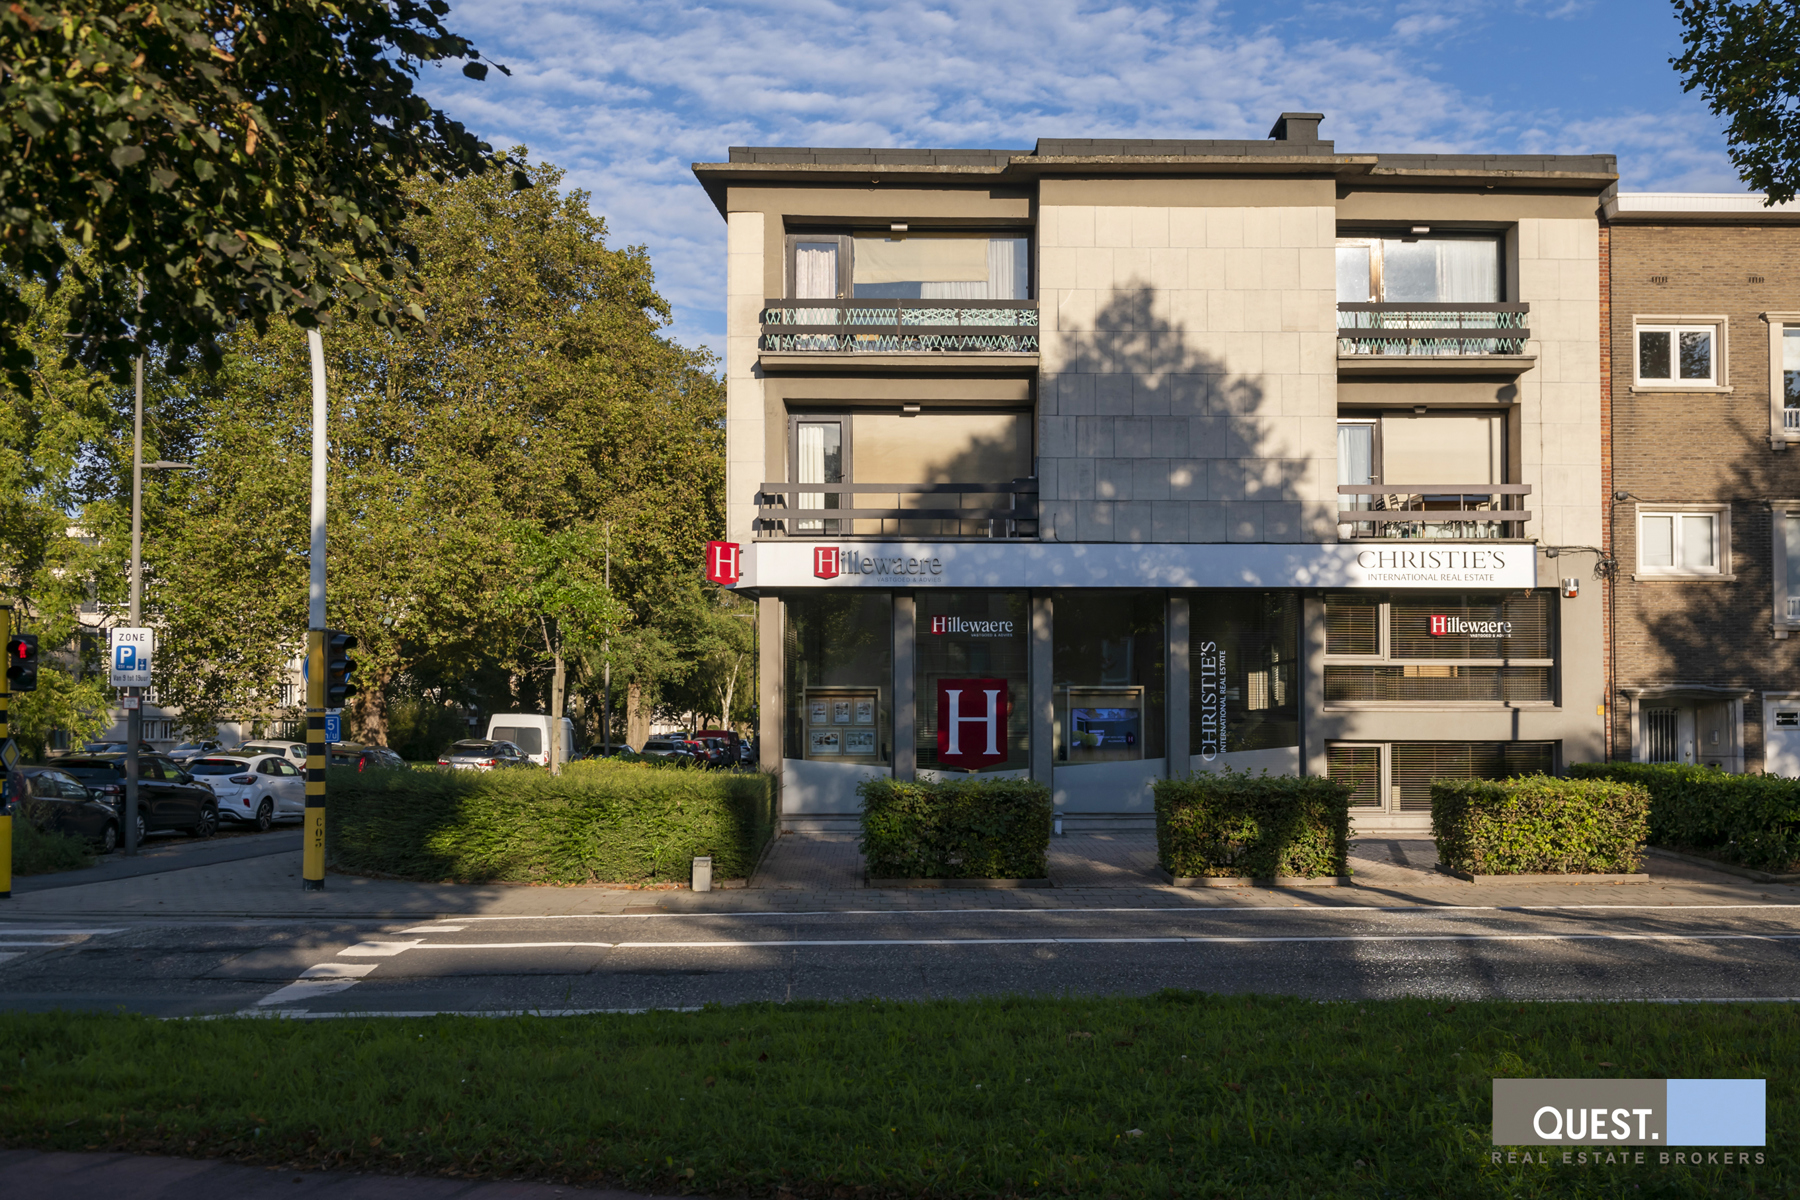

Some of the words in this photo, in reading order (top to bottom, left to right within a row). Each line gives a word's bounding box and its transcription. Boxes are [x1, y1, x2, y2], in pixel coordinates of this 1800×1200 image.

[715, 546, 736, 578] H
[817, 549, 942, 575] Hillewaere
[1357, 550, 1505, 569] CHRISTIE'S
[1368, 573, 1437, 581] INTERNATIONAL
[1440, 573, 1462, 581] REAL
[1464, 573, 1494, 581] ESTATE
[932, 616, 1013, 632] Hillewaere
[1432, 616, 1512, 633] Hillewaere
[119, 633, 145, 641] ZONE
[120, 647, 133, 664] P
[113, 674, 122, 682] Van
[1201, 641, 1217, 761] CHRISTIE'S
[327, 719, 335, 731] 5
[945, 689, 1001, 755] H
